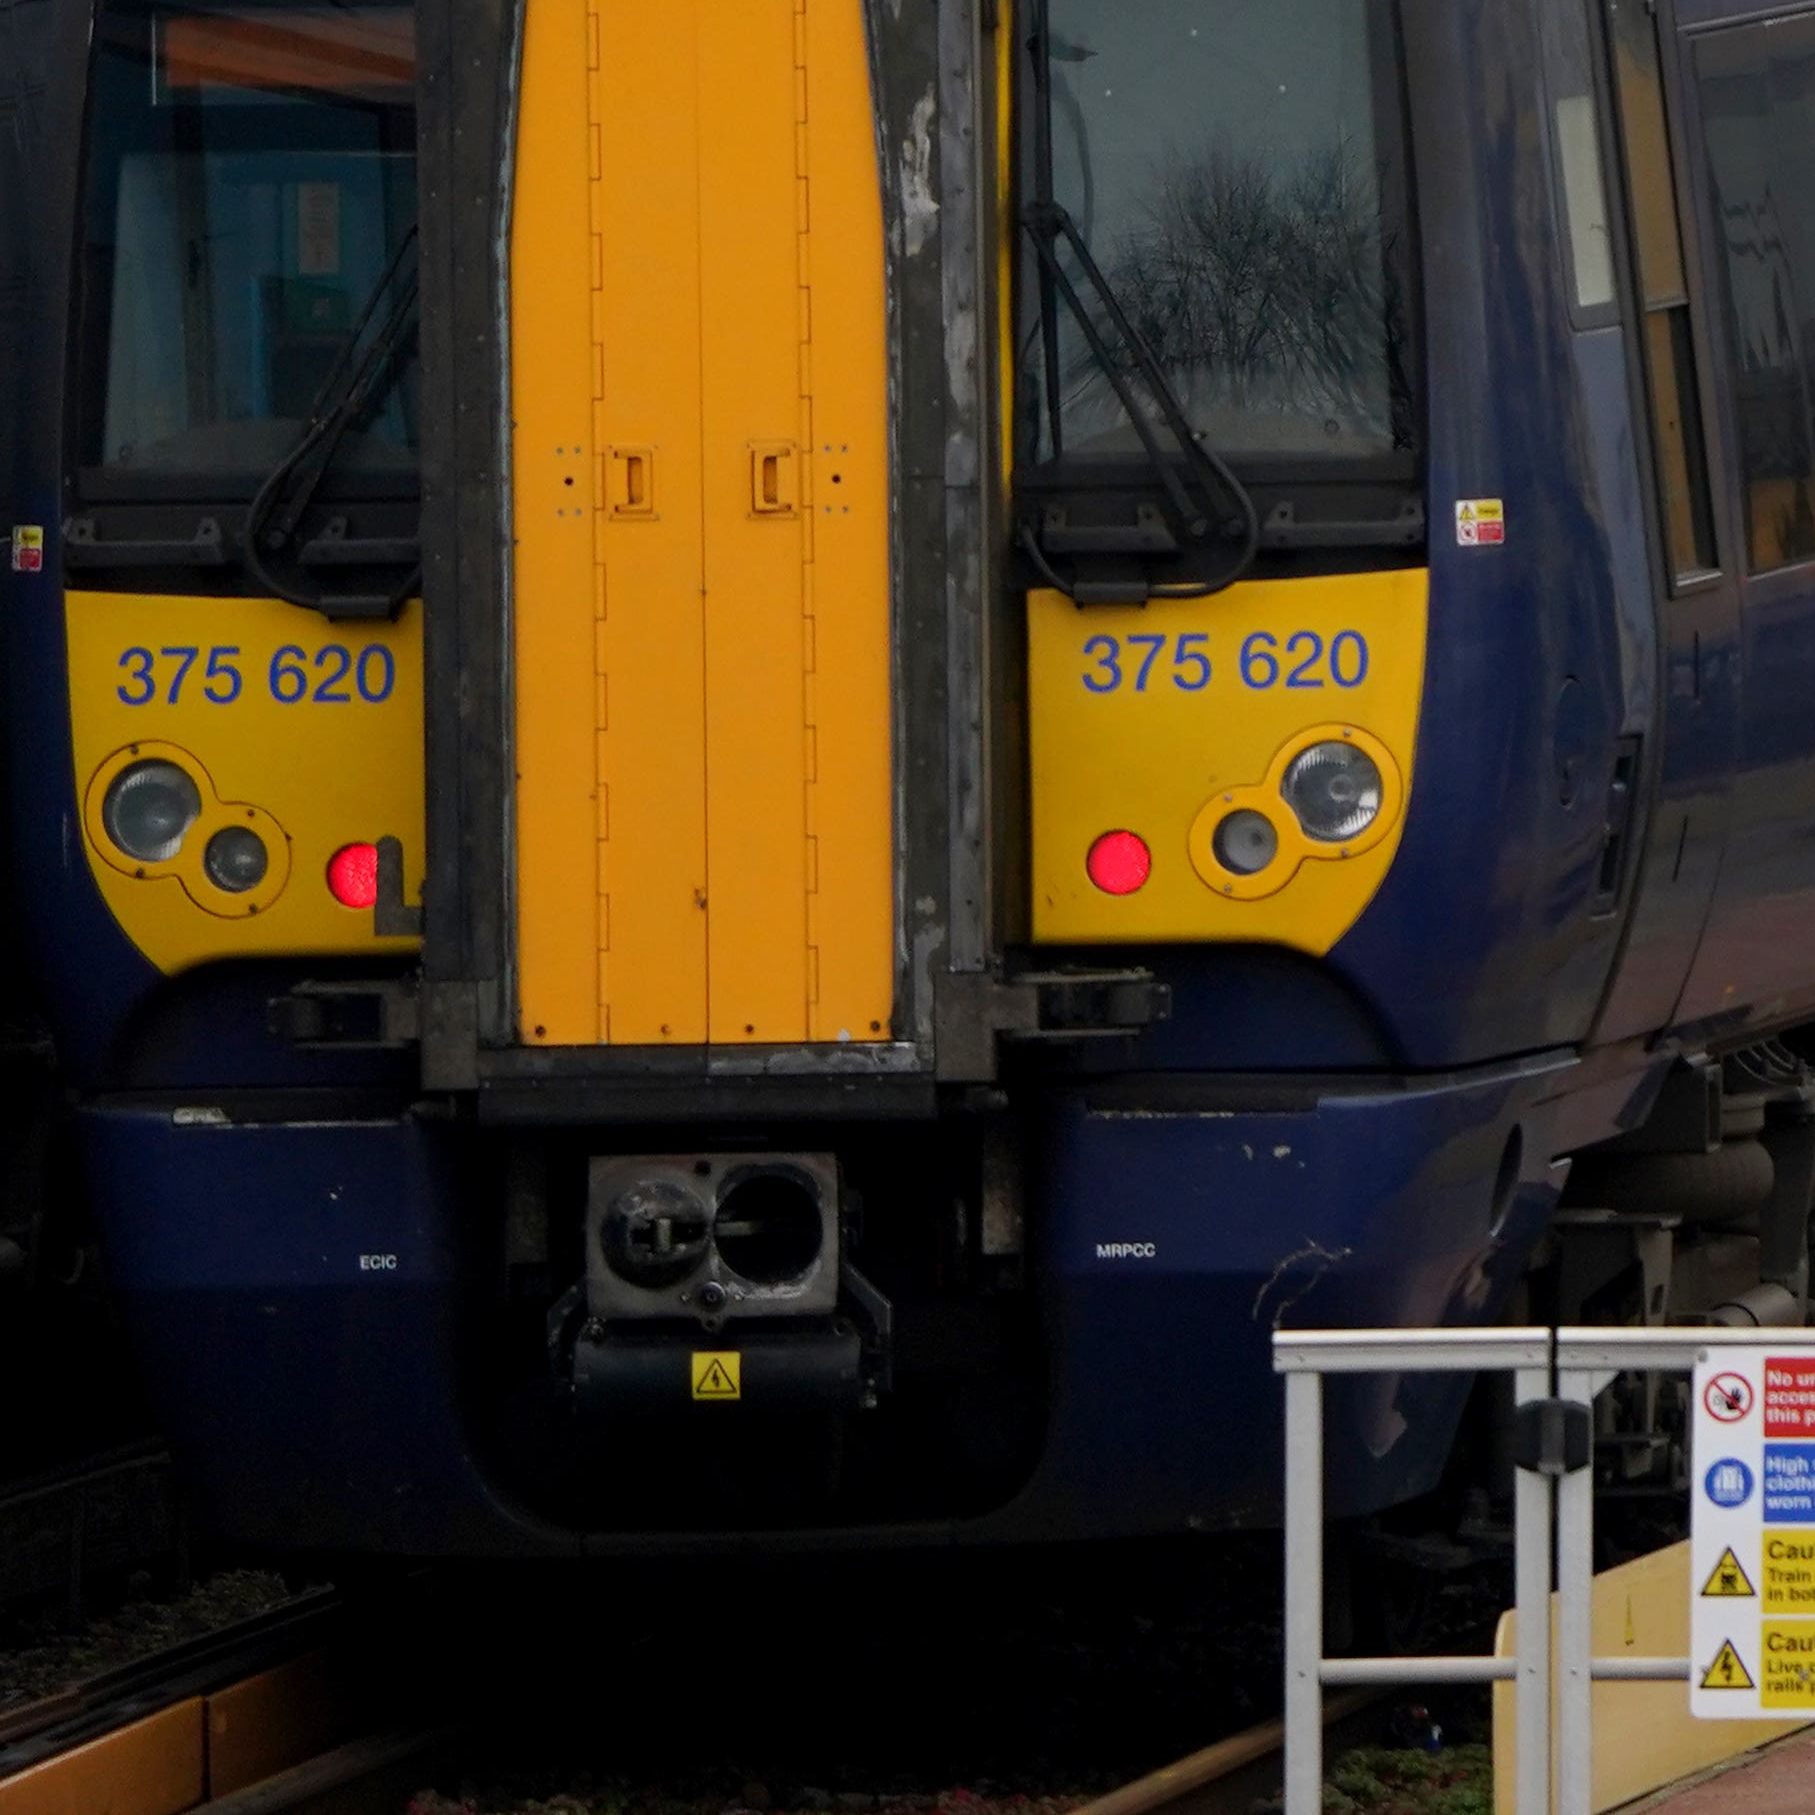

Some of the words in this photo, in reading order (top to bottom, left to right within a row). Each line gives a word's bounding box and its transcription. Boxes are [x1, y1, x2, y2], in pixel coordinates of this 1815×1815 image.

[1082, 633, 1211, 692] 375
[1240, 630, 1368, 690] 620
[117, 646, 243, 705] 375
[269, 644, 395, 703] 620
[1096, 1242, 1156, 1258] MRPCC
[360, 1254, 397, 1270] ECIC
[1766, 1370, 1793, 1387] No
[1766, 1407, 1800, 1423] this
[1766, 1456, 1809, 1474] High
[1766, 1495, 1812, 1509] worn
[1768, 1568, 1812, 1582] Train
[1768, 1587, 1783, 1602] in
[1767, 1661, 1803, 1674] Live
[1767, 1679, 1803, 1693] rails
